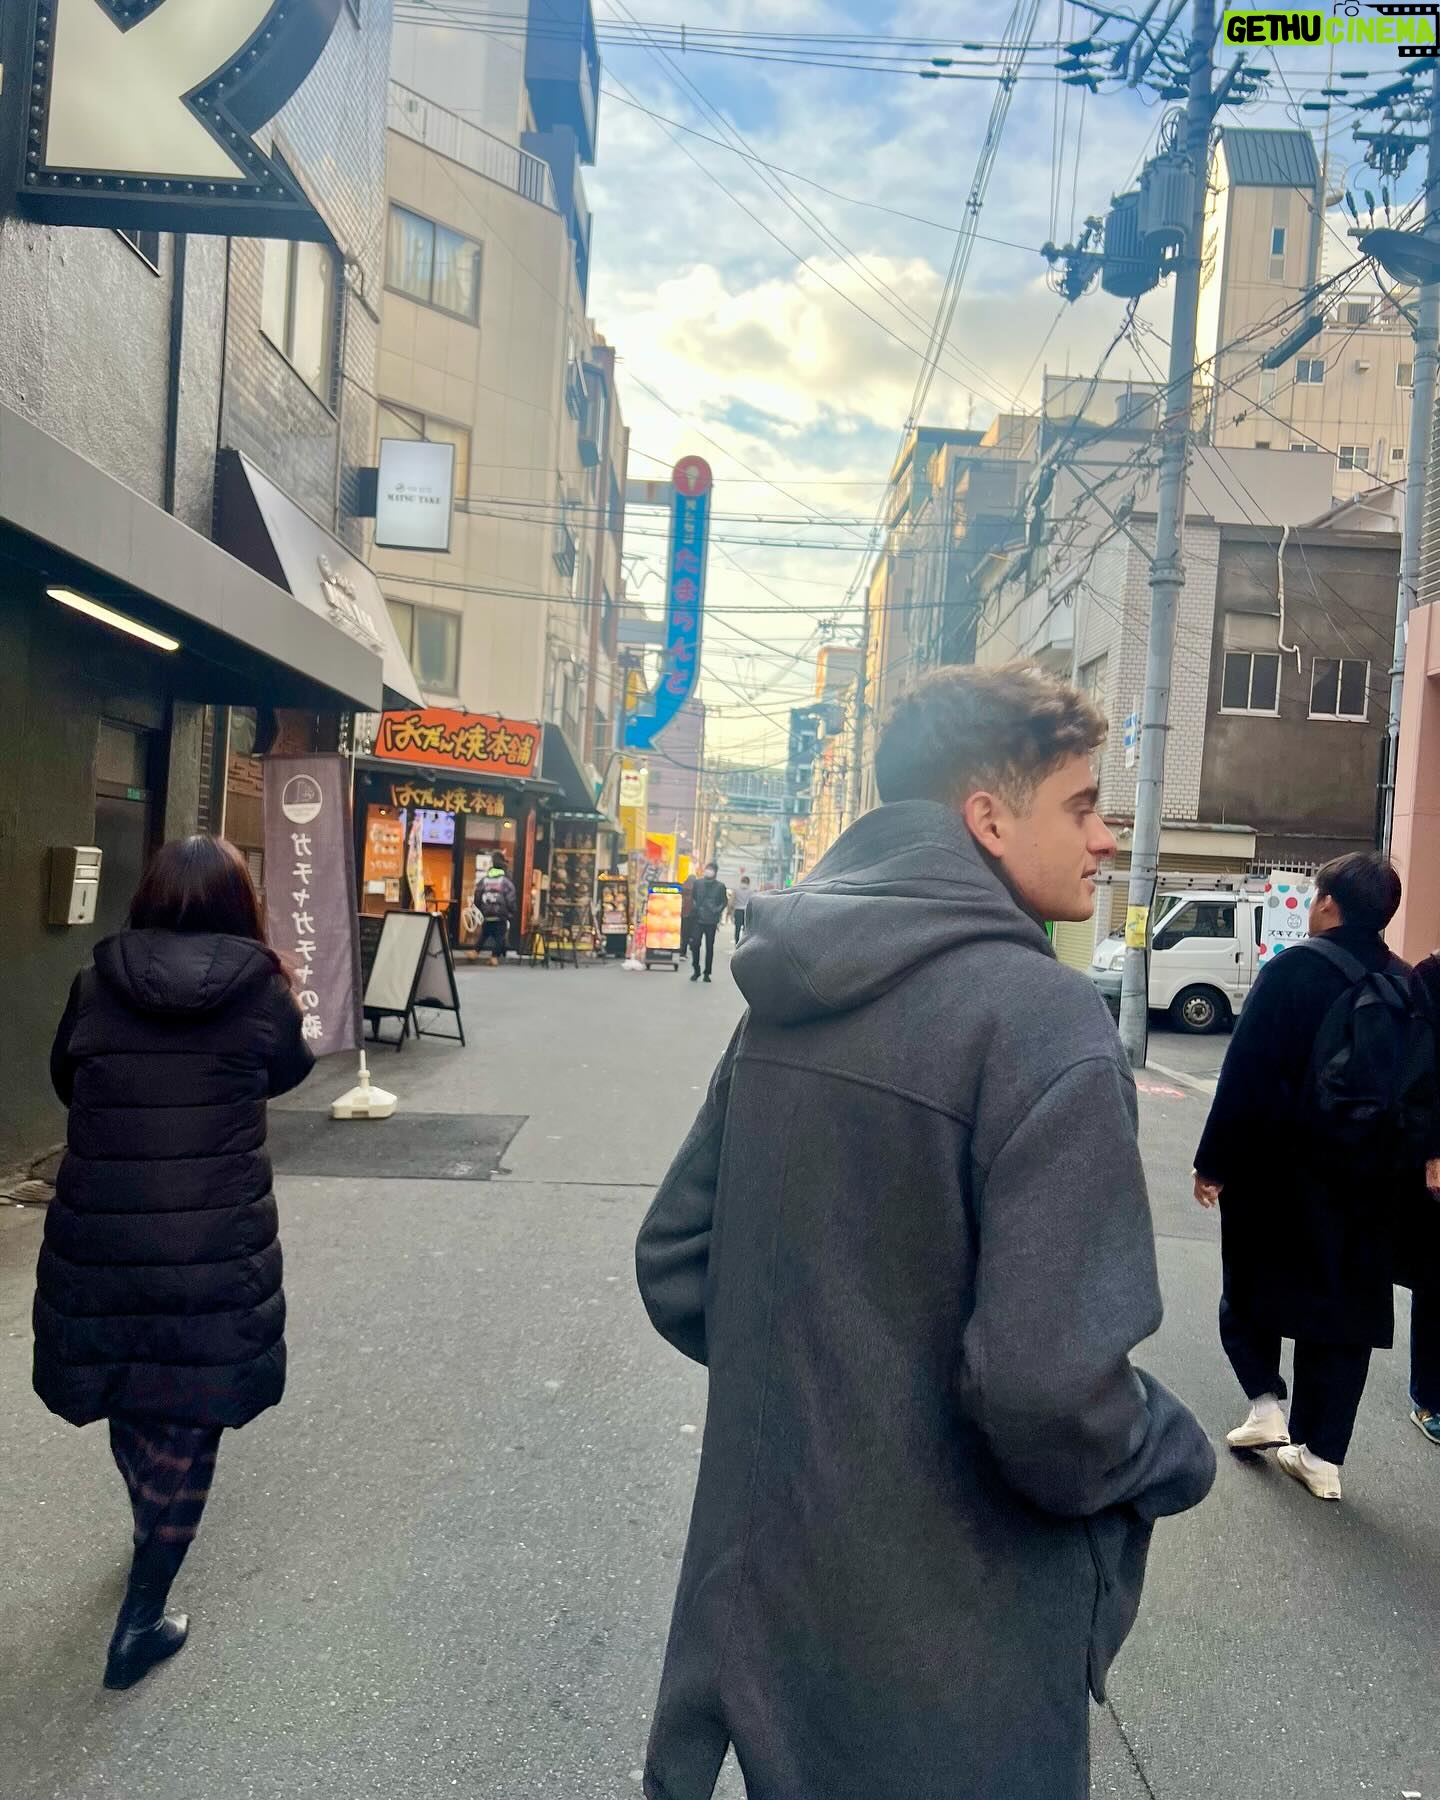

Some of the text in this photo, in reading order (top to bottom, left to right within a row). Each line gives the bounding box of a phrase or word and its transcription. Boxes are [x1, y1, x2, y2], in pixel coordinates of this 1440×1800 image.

[387, 493, 441, 505] MATSU TAKE
[384, 714, 535, 766] ばくだん焼本舗
